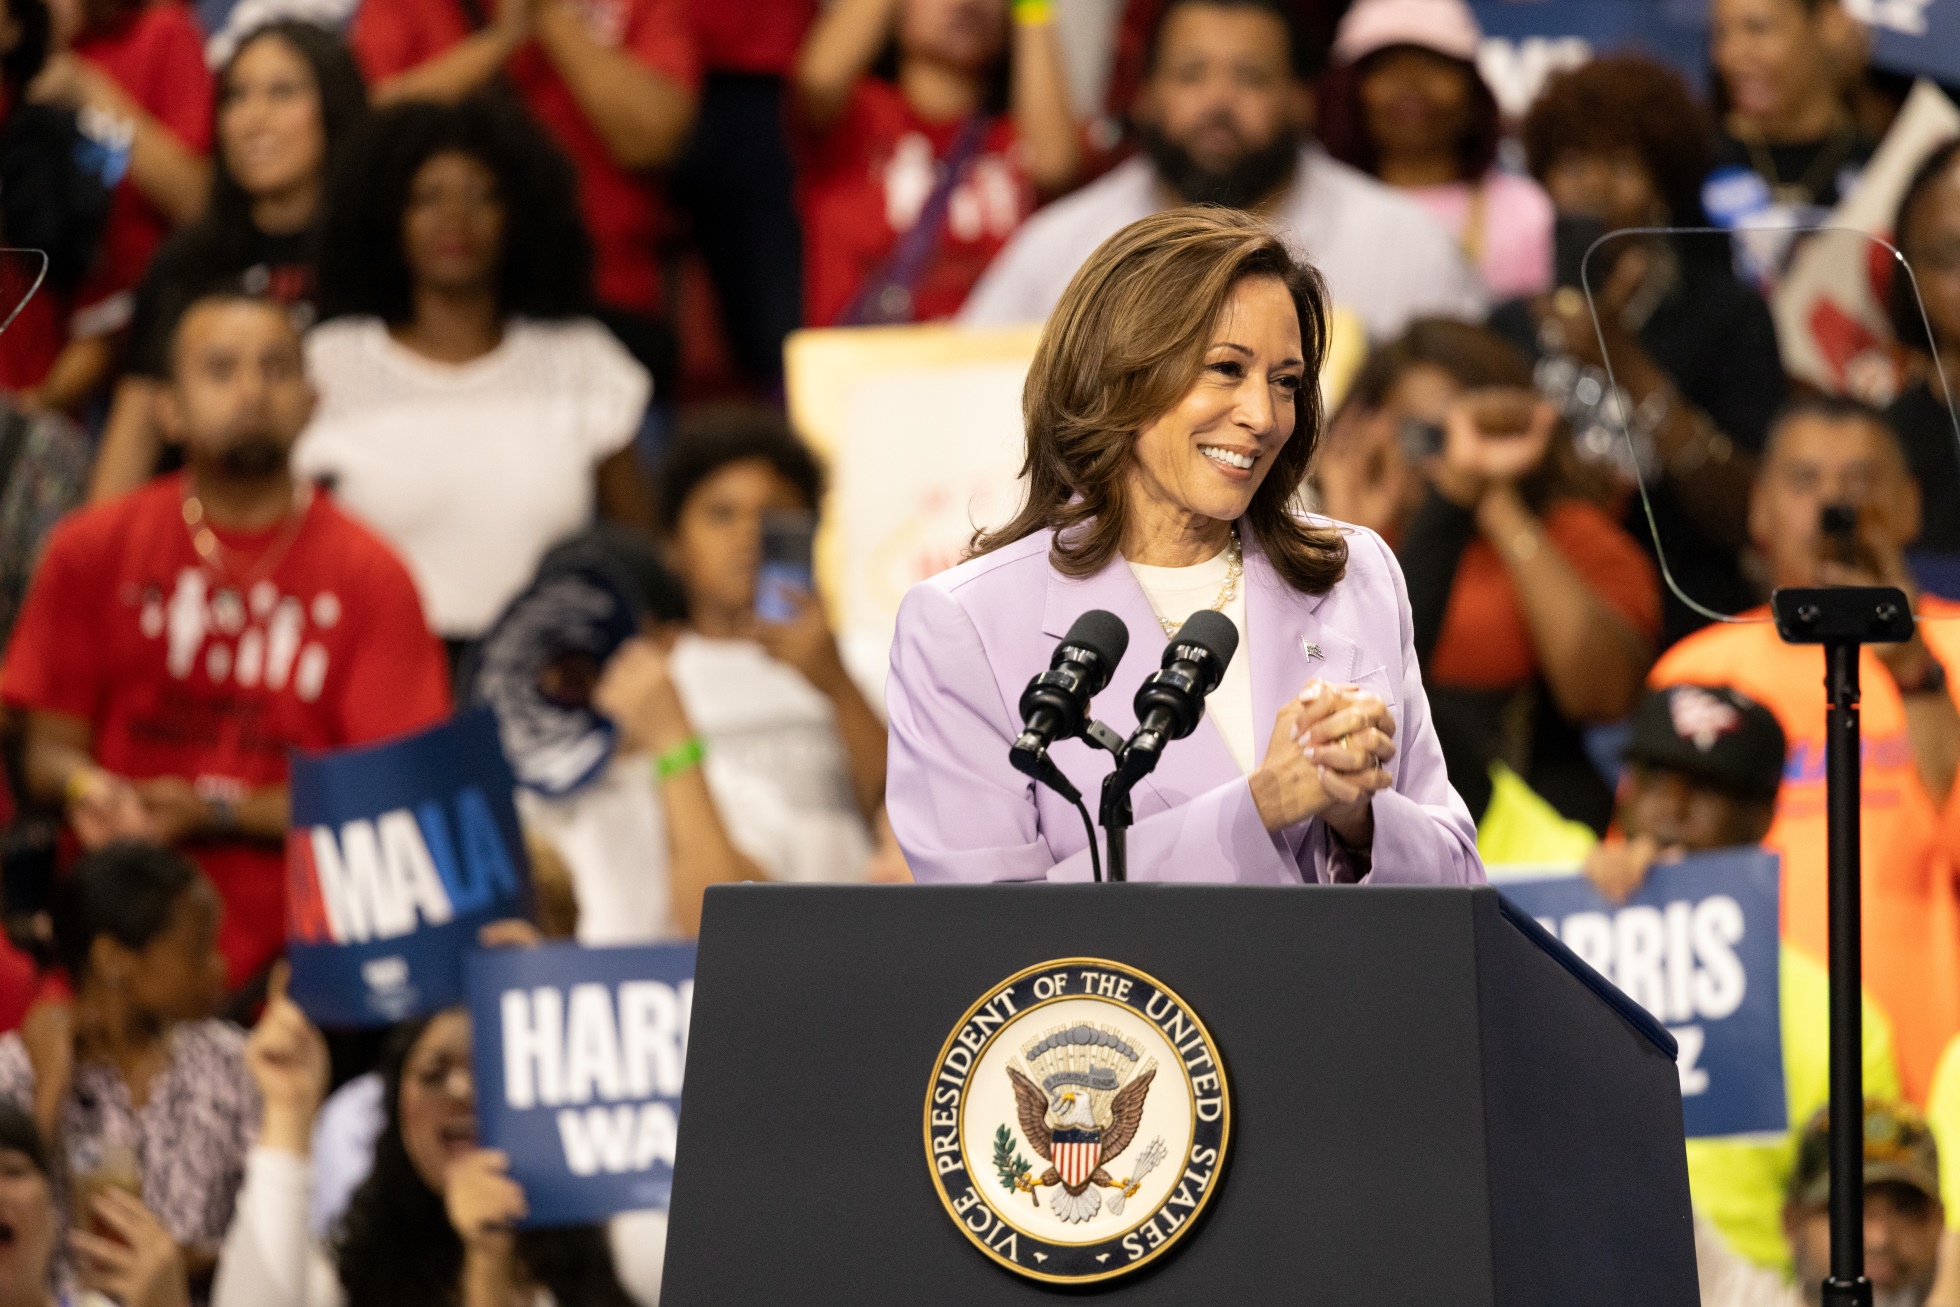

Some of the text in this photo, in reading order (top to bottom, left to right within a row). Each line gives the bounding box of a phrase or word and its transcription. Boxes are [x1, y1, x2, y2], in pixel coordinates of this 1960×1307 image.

[1534, 894, 1747, 1023] RRIS
[501, 978, 695, 1109] HAR
[932, 972, 1222, 1262] VICE PRESIDENT OF THE UNITED STATES
